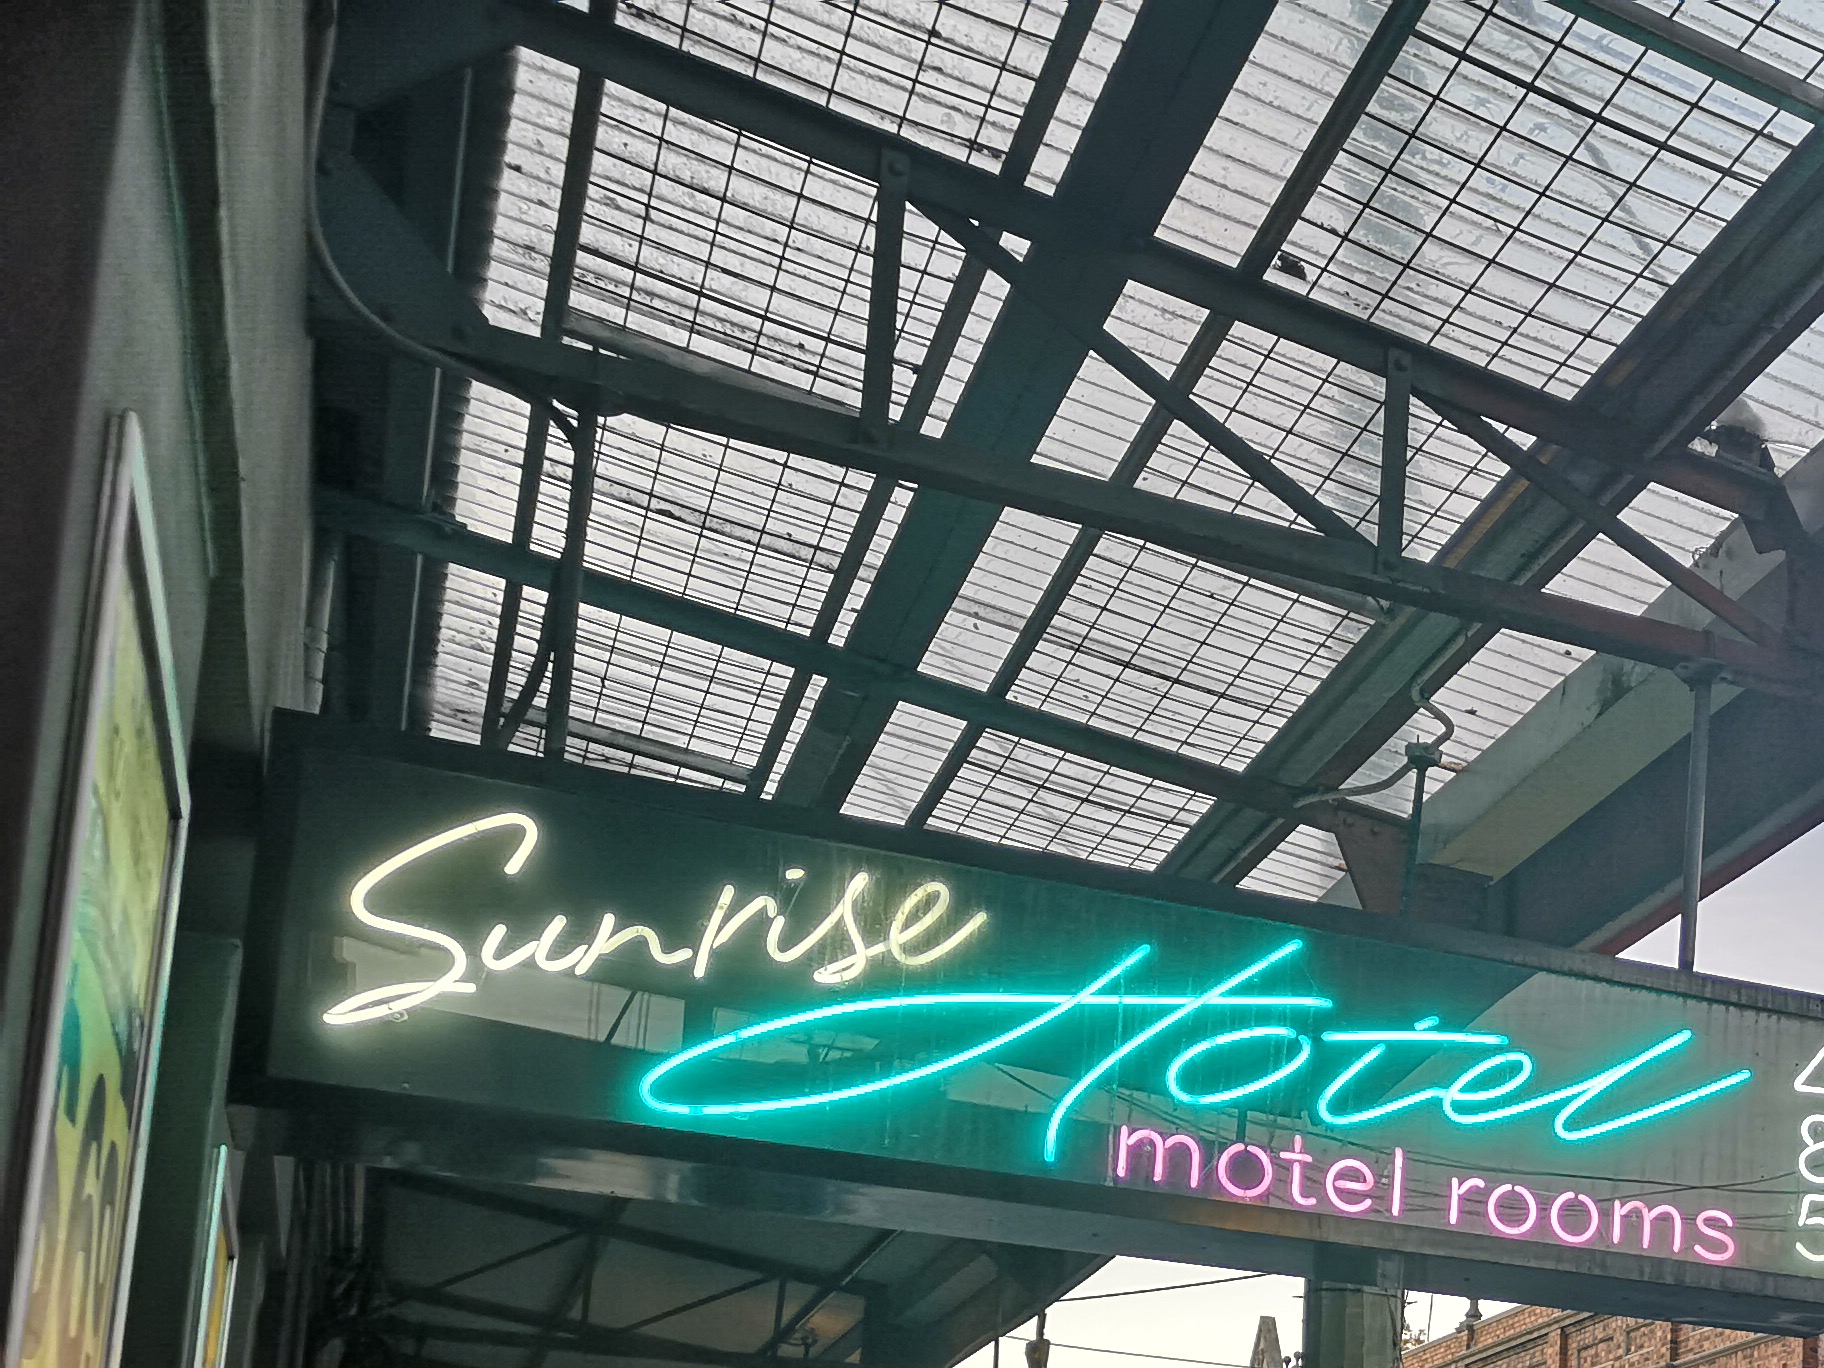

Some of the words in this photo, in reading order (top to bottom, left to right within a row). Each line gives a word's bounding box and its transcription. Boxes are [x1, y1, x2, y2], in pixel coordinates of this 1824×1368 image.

[321, 811, 989, 1025] Sunrise
[637, 938, 1754, 1163] Hotel
[1116, 1123, 1405, 1217] motel
[1448, 1175, 1737, 1264] rooms
